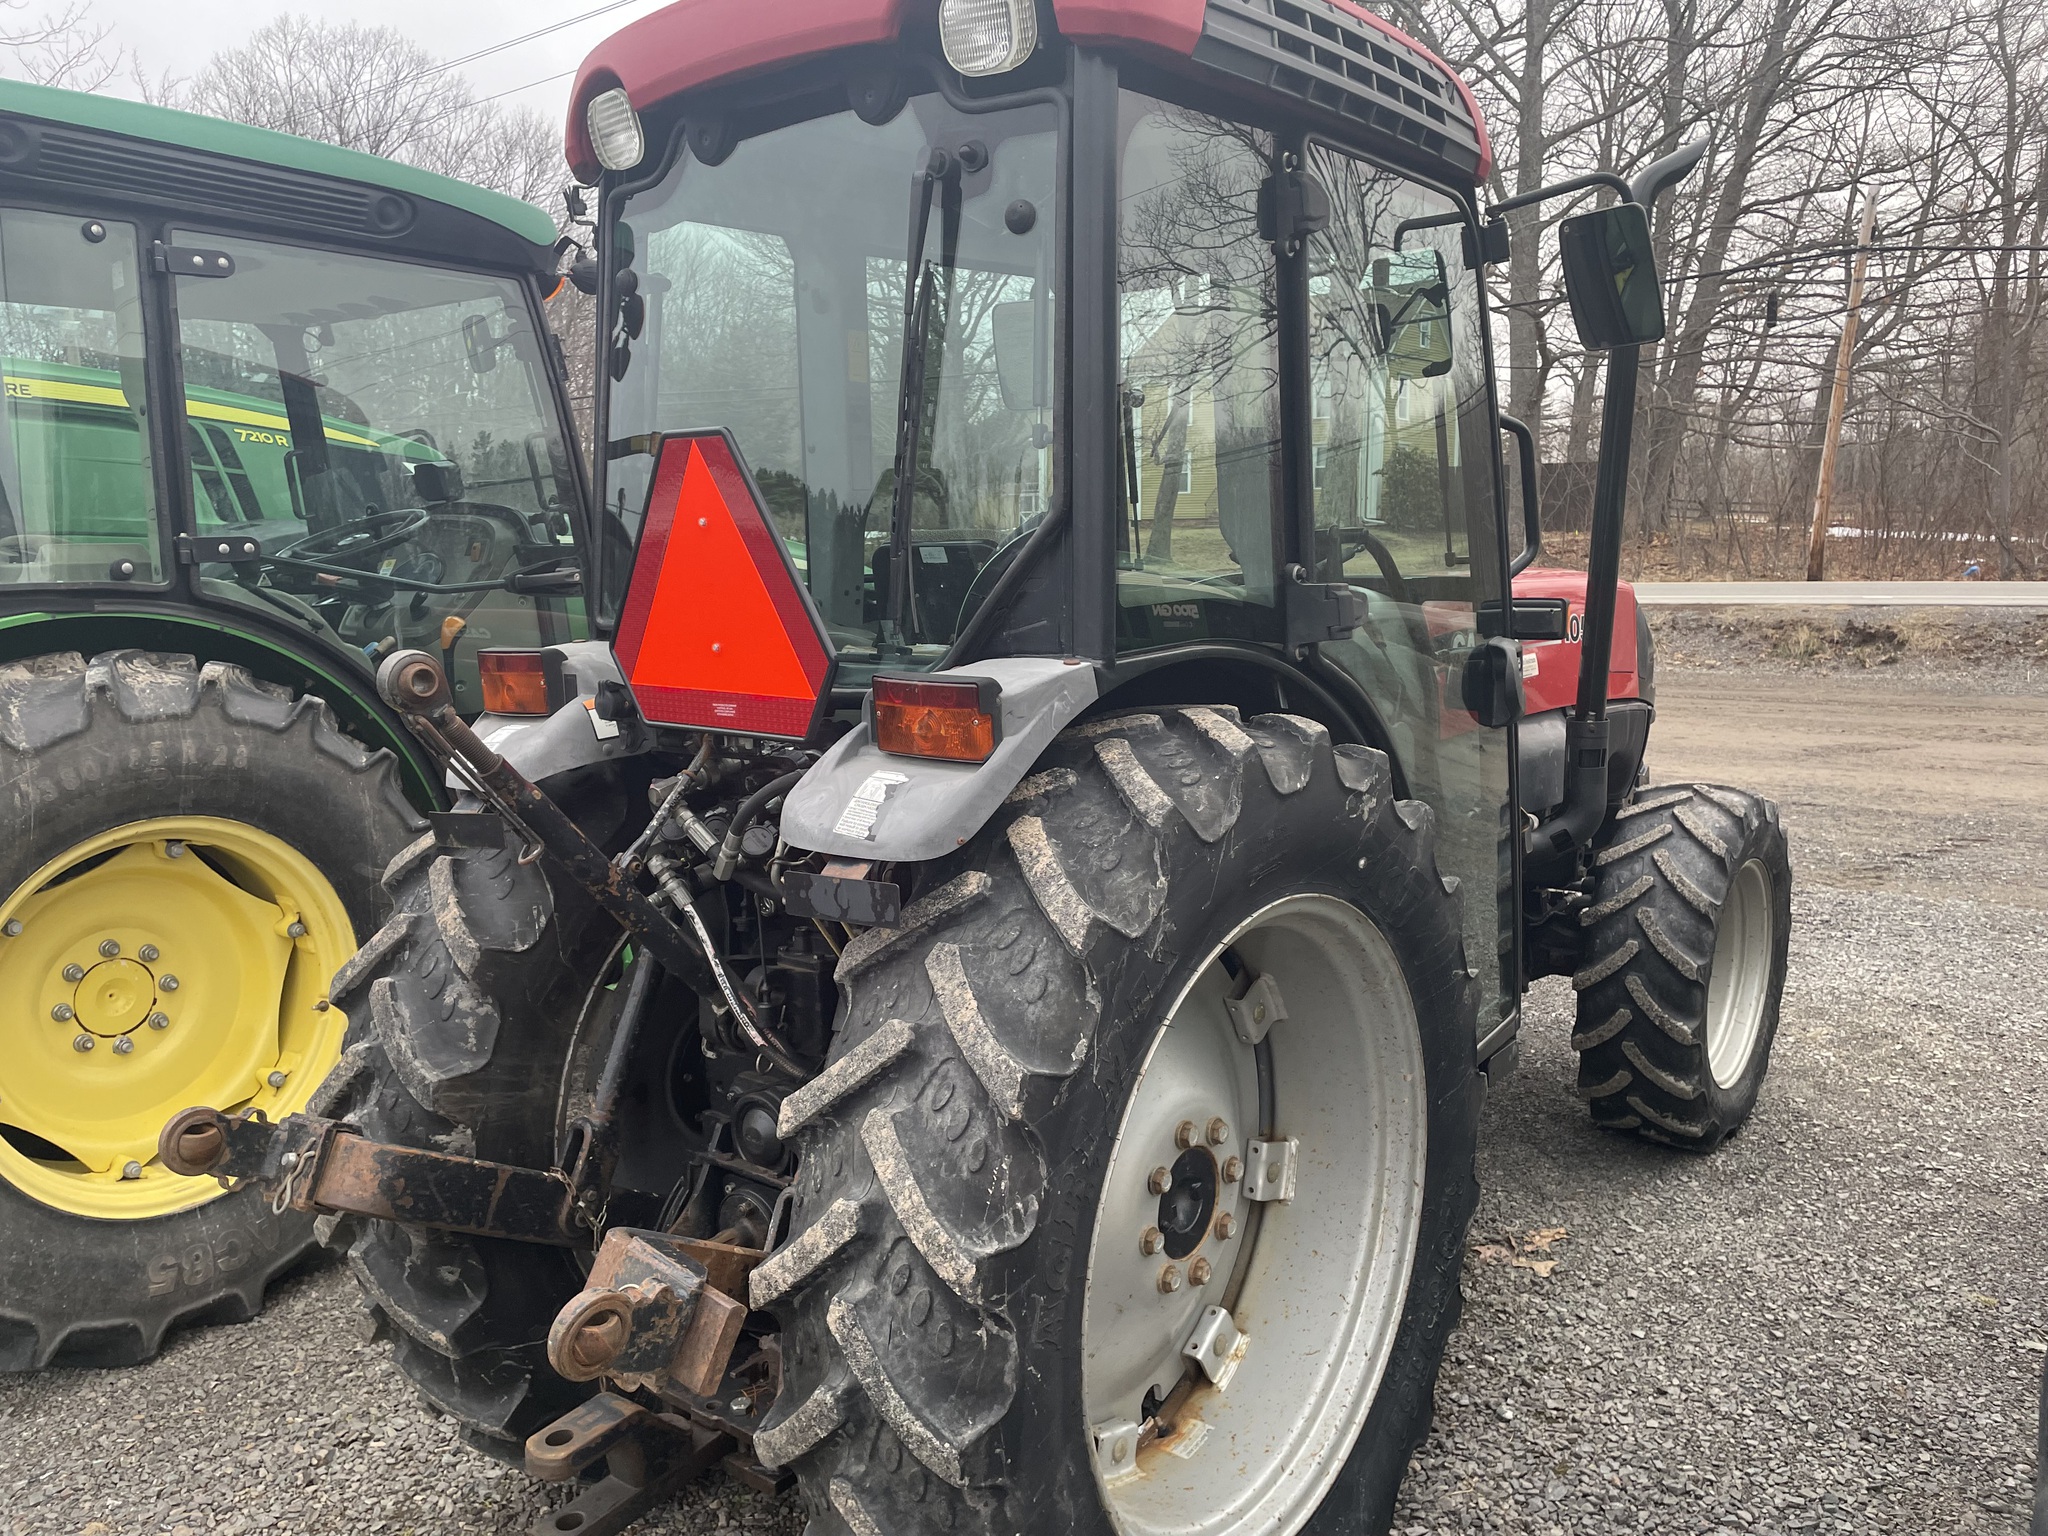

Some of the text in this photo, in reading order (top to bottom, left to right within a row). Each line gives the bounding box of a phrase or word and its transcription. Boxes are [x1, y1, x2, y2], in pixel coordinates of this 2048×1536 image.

[4, 382, 31, 396] RE
[233, 428, 289, 447] 7210 R
